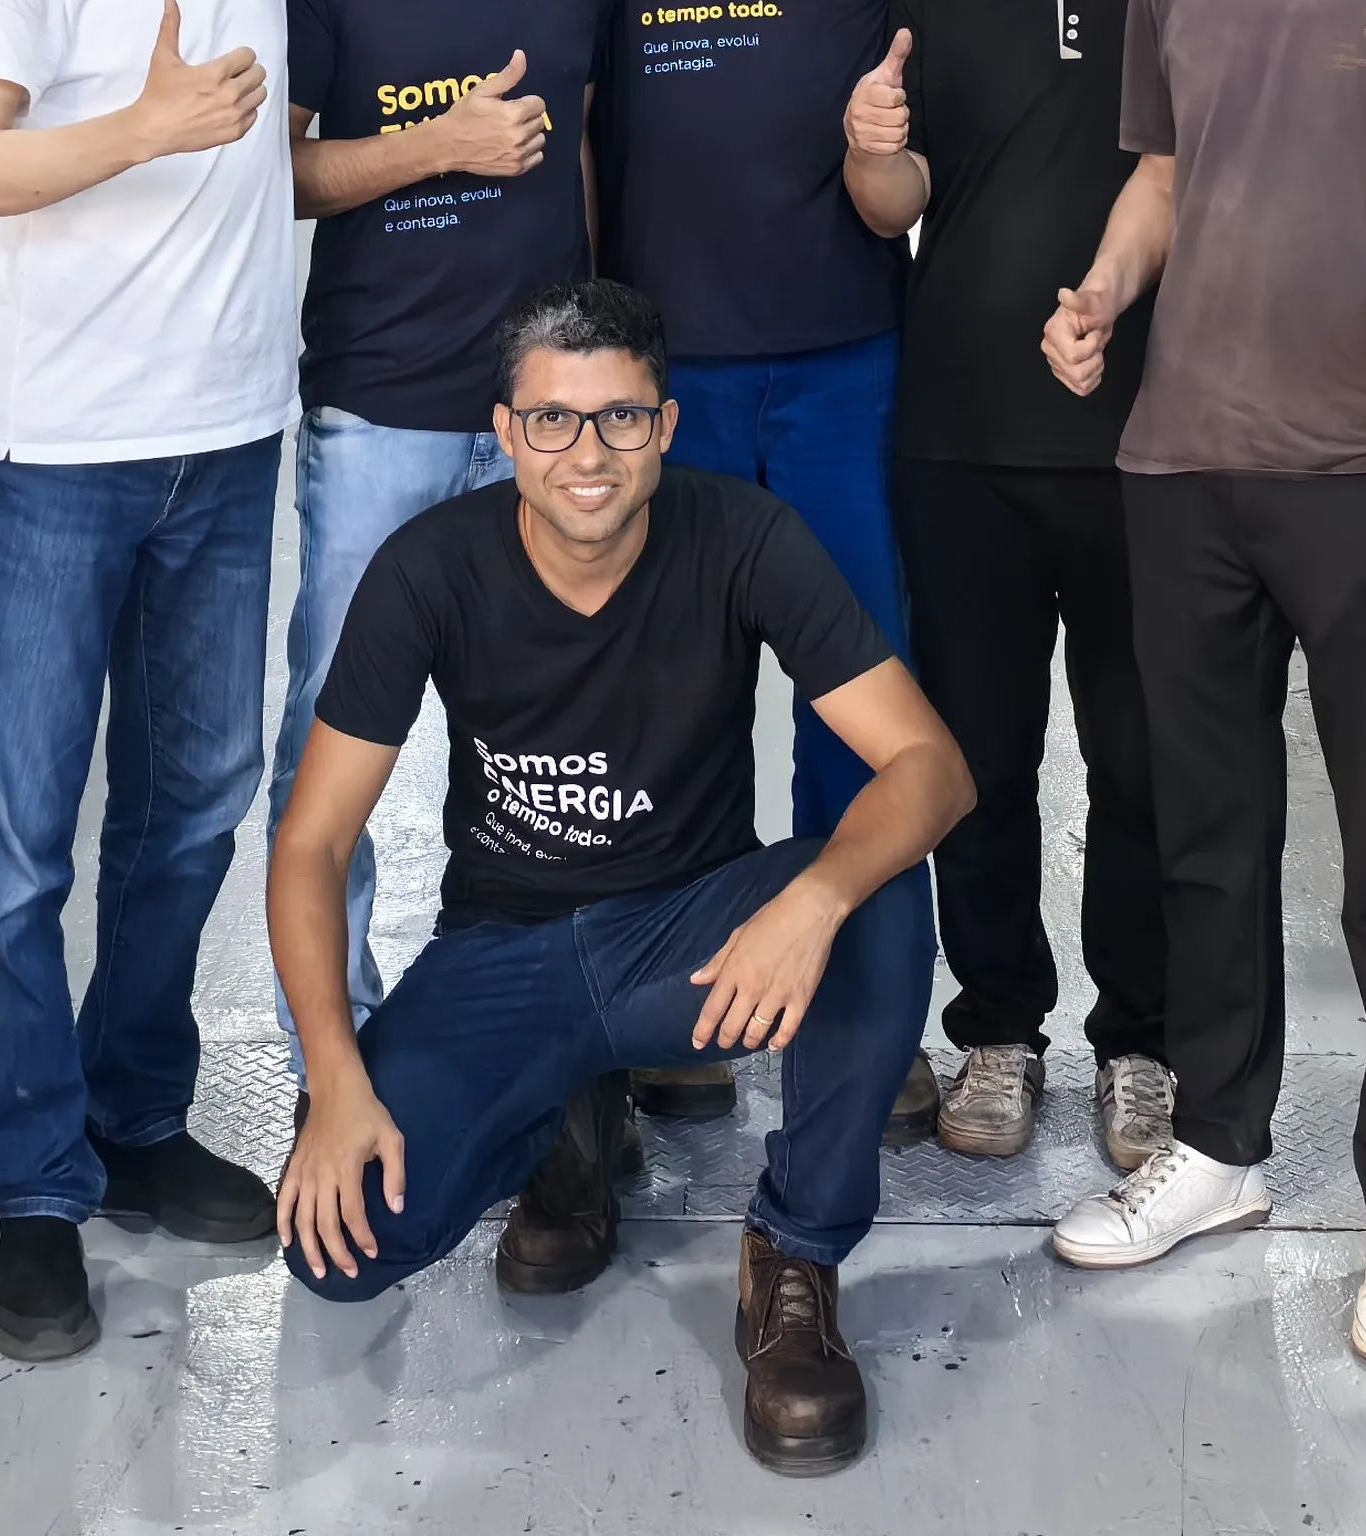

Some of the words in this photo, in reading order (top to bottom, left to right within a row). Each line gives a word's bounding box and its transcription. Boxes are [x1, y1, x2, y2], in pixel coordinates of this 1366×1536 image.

[641, 12, 653, 26] o
[656, 5, 723, 24] tempo
[727, 0, 783, 19] todo.
[643, 41, 669, 55] Que
[671, 37, 713, 52] inova,
[716, 32, 759, 48] evolui
[644, 63, 652, 75] e
[654, 55, 716, 74] contagia.
[377, 71, 500, 116] Somo
[384, 198, 411, 212] Que
[414, 193, 458, 210] inova,
[461, 185, 502, 203] evolui
[385, 221, 393, 233] e
[396, 212, 461, 232] contagia.
[473, 736, 608, 777] Somos
[485, 811, 505, 836] Que
[487, 788, 501, 804] o
[501, 792, 563, 837] tempo
[563, 824, 612, 847] todo.
